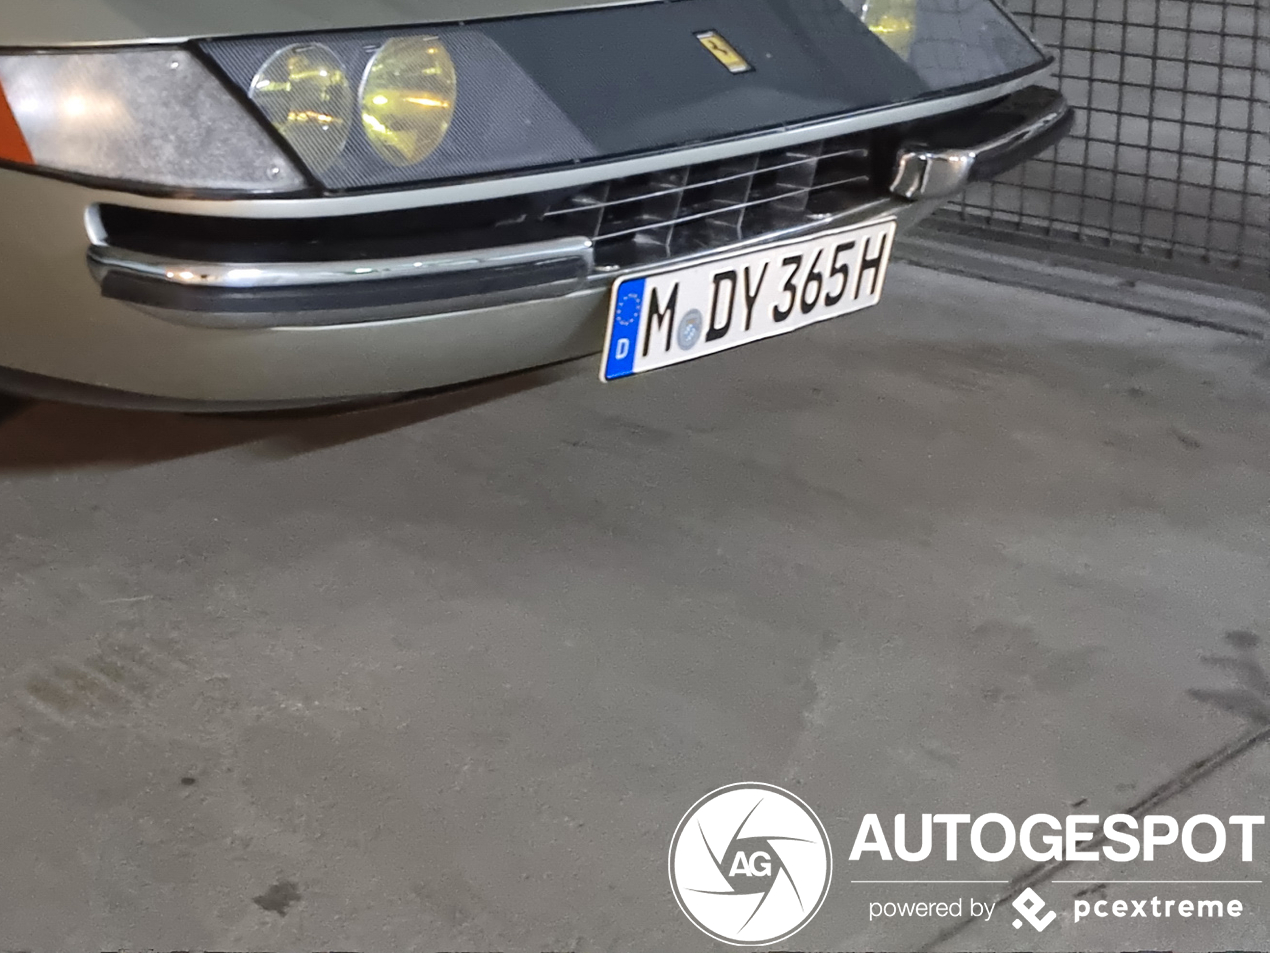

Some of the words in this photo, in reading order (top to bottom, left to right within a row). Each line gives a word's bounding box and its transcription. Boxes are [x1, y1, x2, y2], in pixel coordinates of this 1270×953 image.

[642, 282, 680, 357] M
[705, 261, 771, 342] DY
[772, 231, 888, 323] 365H
[615, 338, 630, 360] D
